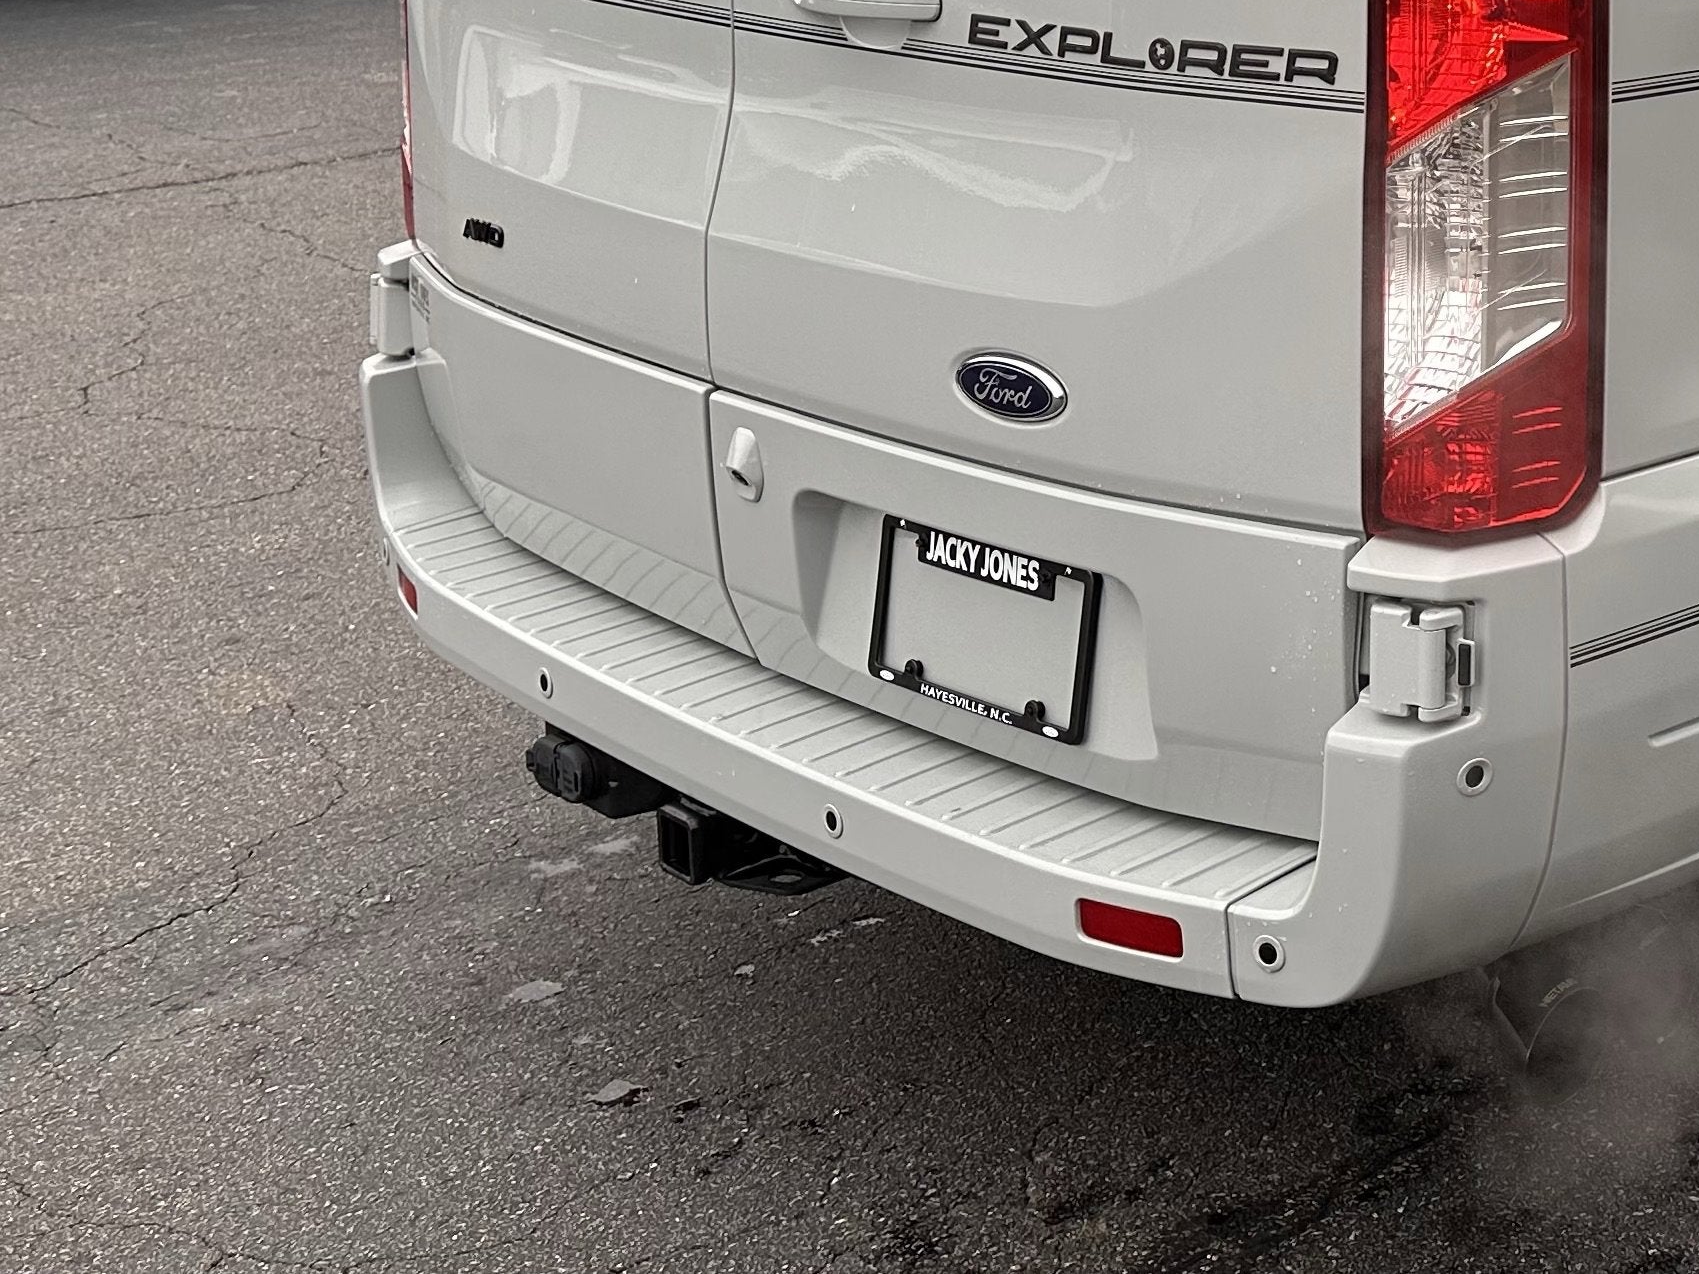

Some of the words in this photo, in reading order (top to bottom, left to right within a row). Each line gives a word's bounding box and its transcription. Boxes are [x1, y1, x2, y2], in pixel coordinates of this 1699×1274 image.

[968, 13, 1338, 86] EXPLORER
[974, 367, 1032, 408] Ford
[926, 531, 980, 573] JACKY
[981, 547, 1040, 591] JONES
[920, 683, 988, 714] HAYESVILLE,
[990, 710, 1013, 725] N.C.
